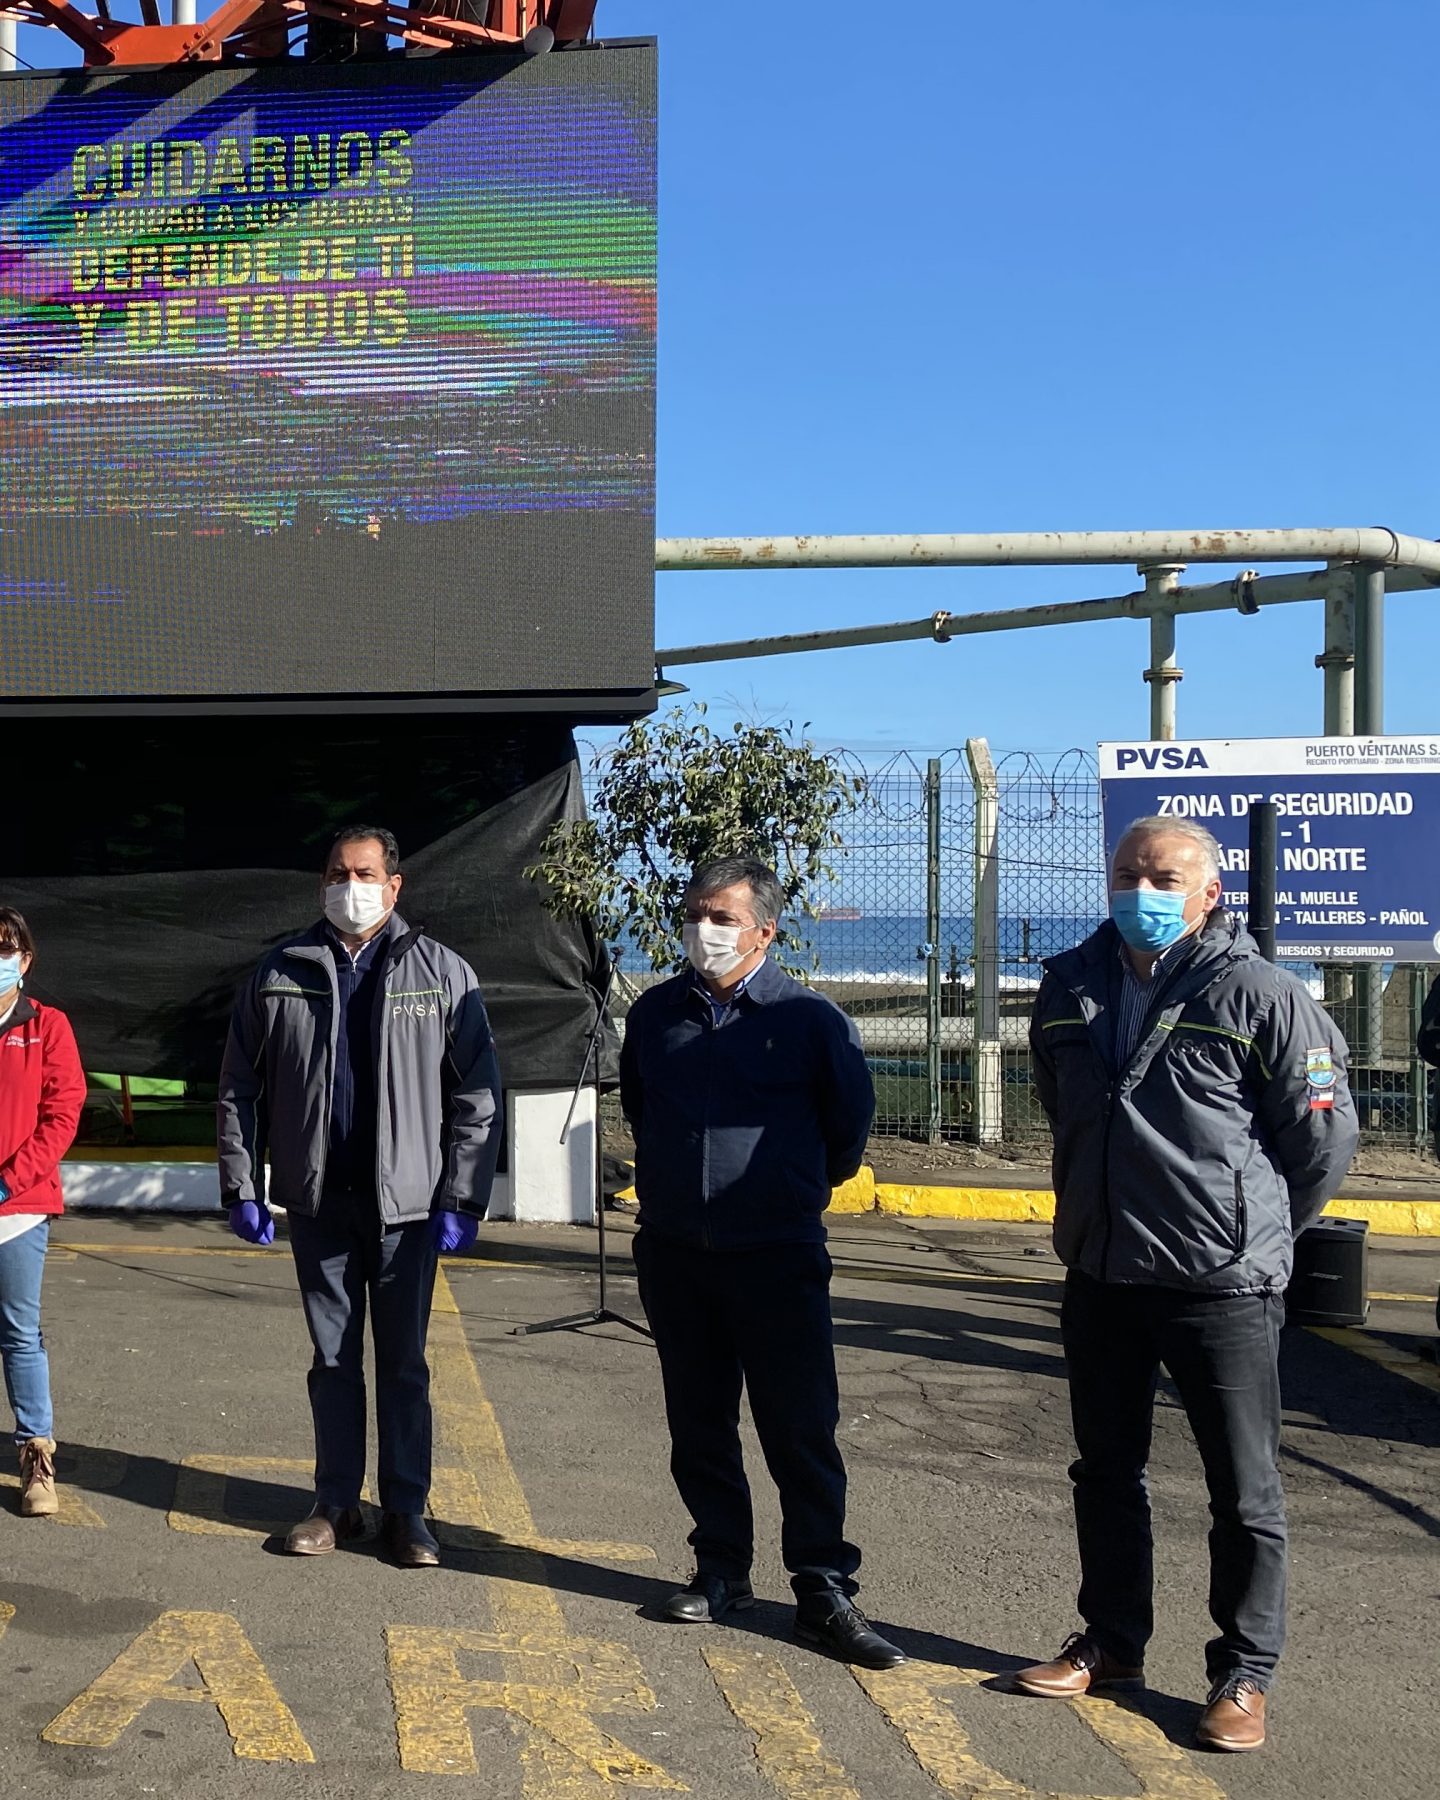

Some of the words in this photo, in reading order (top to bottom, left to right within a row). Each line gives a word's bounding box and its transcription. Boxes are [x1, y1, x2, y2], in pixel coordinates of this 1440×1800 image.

[72, 129, 414, 200] CUIDARNOS
[72, 240, 281, 292] DEPENDE
[299, 235, 357, 282] DE
[373, 233, 414, 280] TI
[70, 302, 104, 357] Y
[126, 297, 197, 353] DE
[218, 288, 409, 351] TODOS
[1116, 747, 1210, 770] PVSA
[1305, 745, 1355, 757] PUERTO
[1358, 743, 1426, 757] VENTANAS
[1306, 758, 1336, 766] RECINTO
[1338, 757, 1380, 765] PORTUARIO
[1385, 757, 1404, 765] ZONA
[1157, 794, 1226, 818] ZONA
[1269, 792, 1413, 816] SEGURIDAD
[1298, 820, 1311, 843] 1
[1283, 848, 1367, 871] NORTE
[1300, 891, 1359, 905] MUELLE
[1293, 911, 1366, 925] TALLERES
[1380, 908, 1429, 925] PAÑOL
[1276, 946, 1322, 956] RIESGOS
[1323, 946, 1331, 956] Y
[1333, 946, 1394, 956] SEGURIDAD
[392, 1003, 438, 1020] PVSA
